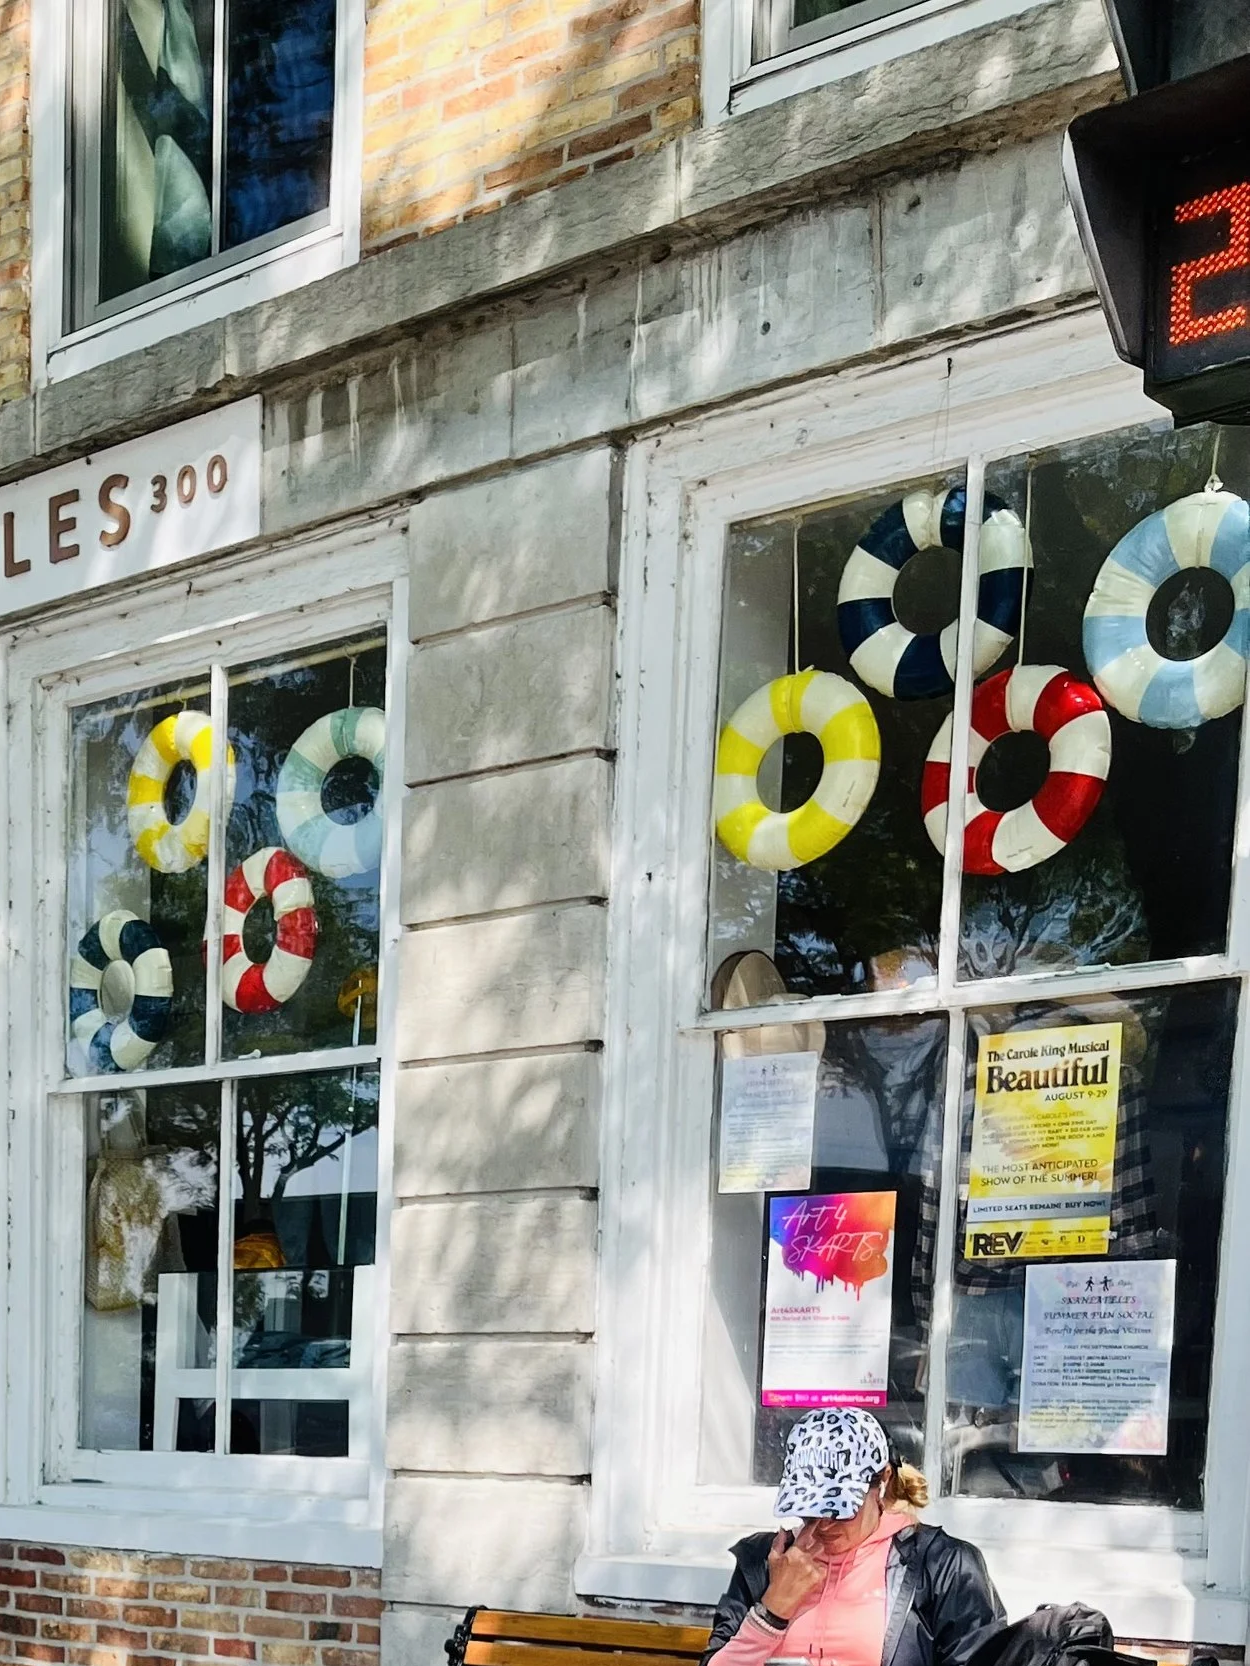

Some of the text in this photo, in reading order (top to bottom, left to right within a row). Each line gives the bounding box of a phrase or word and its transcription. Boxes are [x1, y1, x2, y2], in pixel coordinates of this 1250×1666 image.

[1169, 180, 1250, 345] 2
[150, 454, 229, 514] 300
[988, 1040, 1109, 1062] The Carole King Musical
[986, 1055, 1110, 1094] Beautiful
[1045, 1089, 1108, 1101] AUGUST 9-29
[982, 1158, 1099, 1174] THE MOST ANTICIPATED
[981, 1172, 1098, 1187] SHOW OF THE SUMMER!
[781, 1200, 848, 1236] Art 4
[973, 1205, 1003, 1213] LIMITED
[1004, 1203, 1028, 1211] SEATS
[1065, 1201, 1082, 1209] BUY
[973, 1231, 1024, 1256] REV
[1043, 1311, 1089, 1320] SUMMER
[1090, 1311, 1115, 1320] FUN
